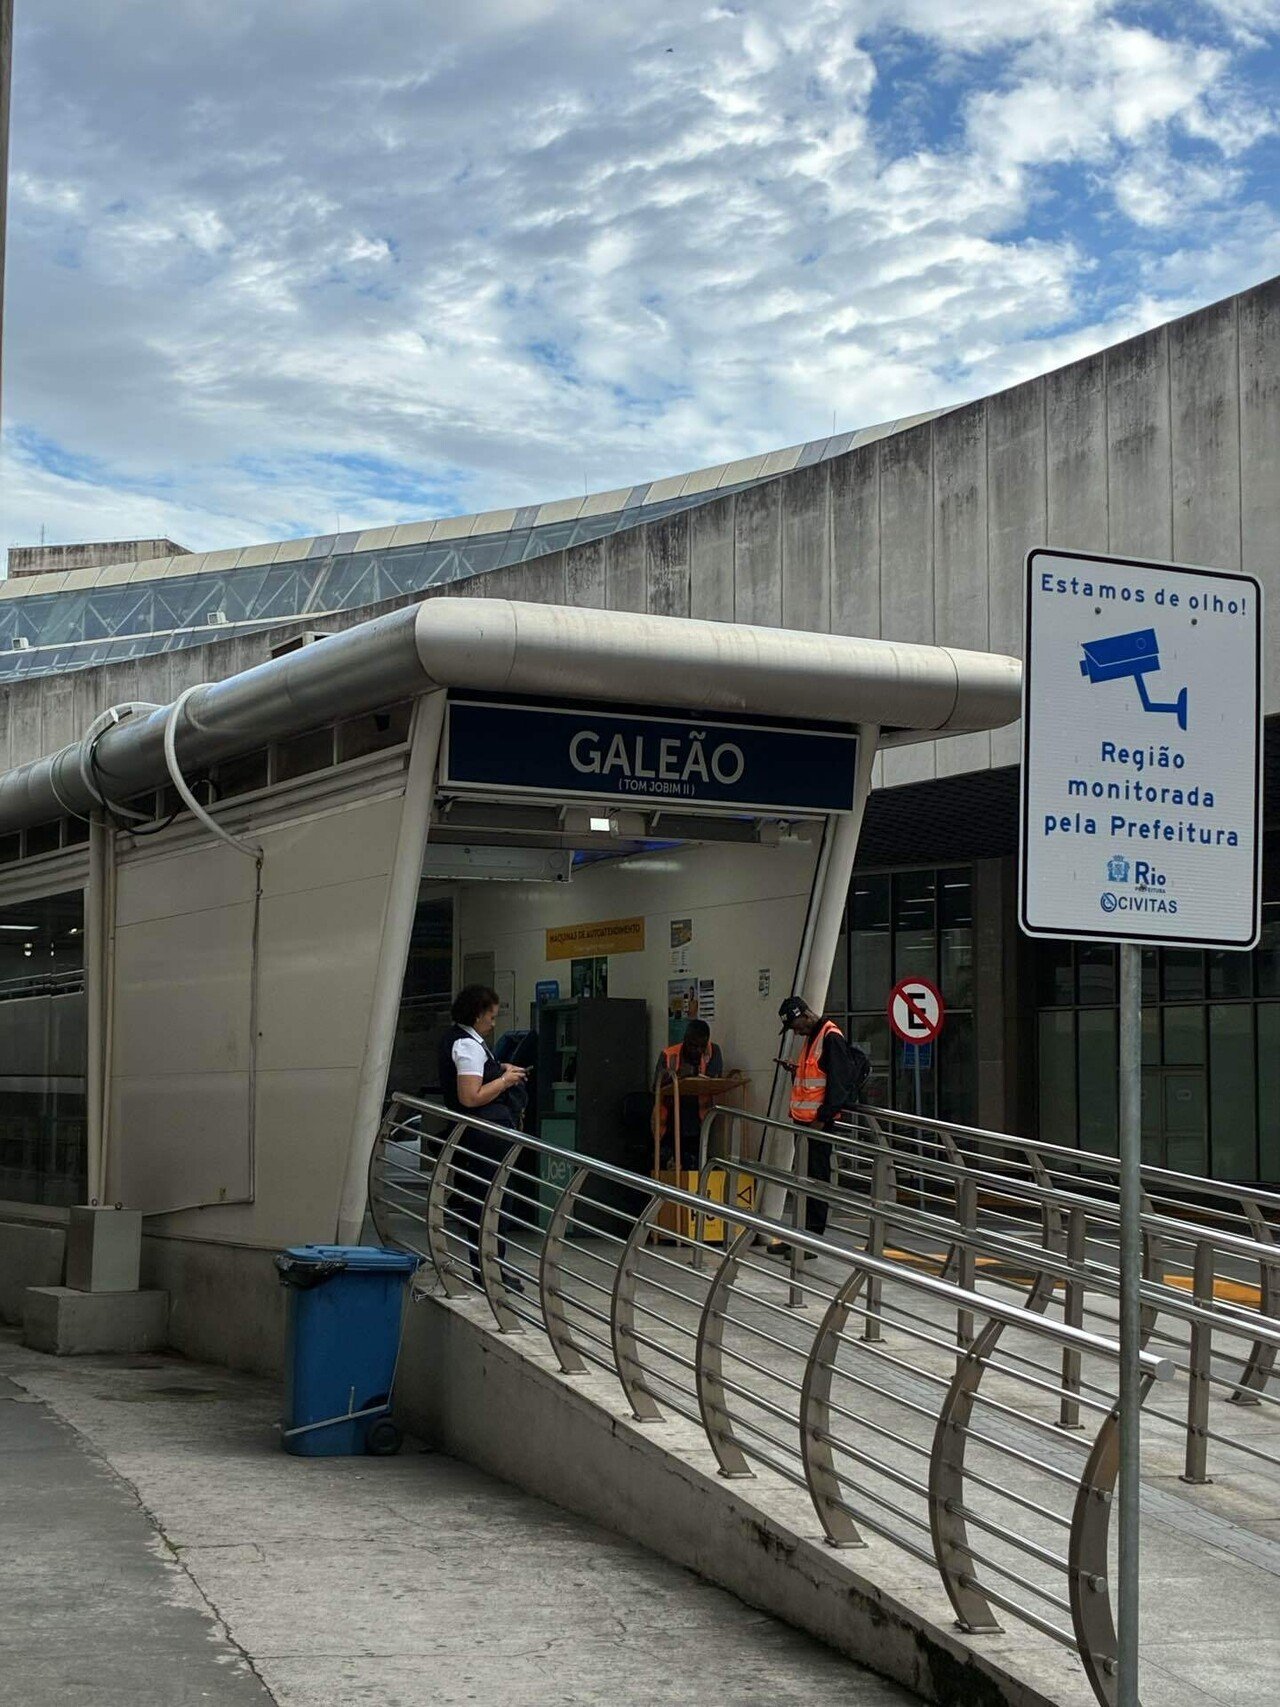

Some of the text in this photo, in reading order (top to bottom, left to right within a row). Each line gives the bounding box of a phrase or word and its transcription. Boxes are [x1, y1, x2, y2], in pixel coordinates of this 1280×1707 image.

[1041, 573, 1247, 616] Estamos de olho!
[569, 730, 745, 785] GALEÃO
[1101, 742, 1185, 771] Região
[649, 781, 681, 794] JOBIM
[1068, 779, 1214, 808] monitorada
[1044, 812, 1239, 847] pela Prefeitura
[1135, 861, 1167, 886] Rio
[1118, 896, 1178, 914] CIVITAS
[907, 992, 927, 1030] E
